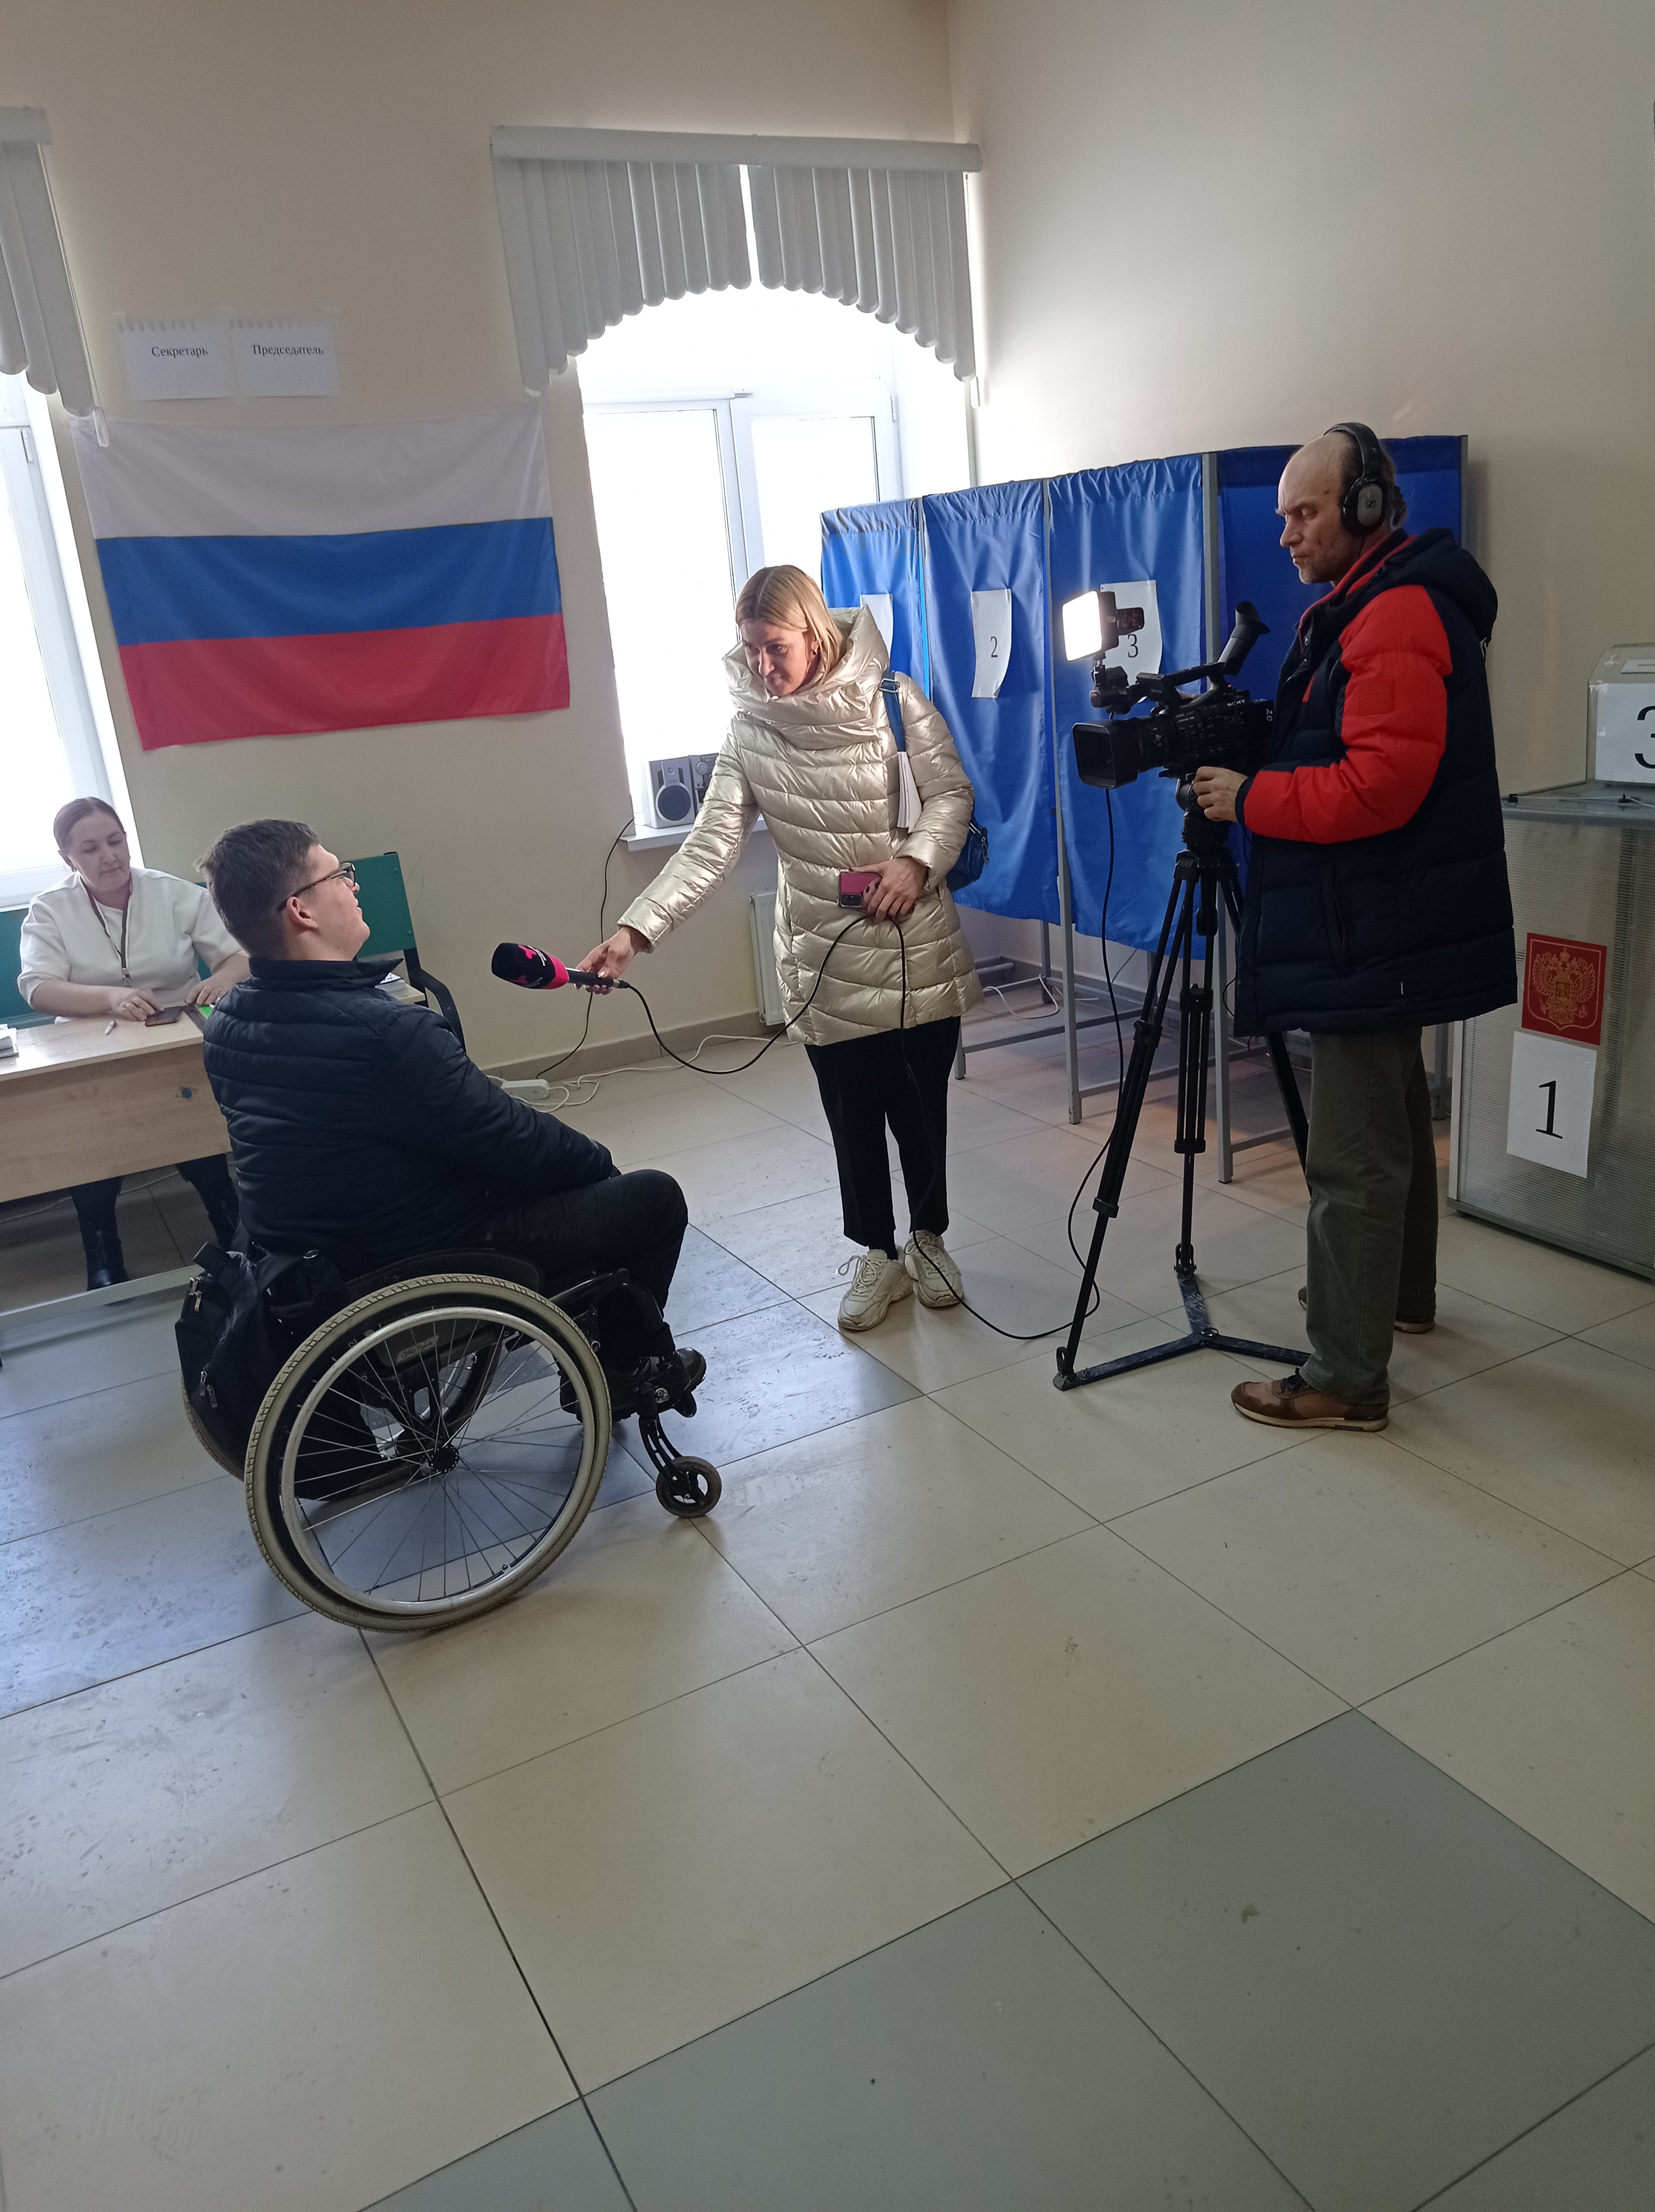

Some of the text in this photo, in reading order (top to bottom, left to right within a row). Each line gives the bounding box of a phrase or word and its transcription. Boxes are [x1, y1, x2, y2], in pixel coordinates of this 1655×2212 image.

[152, 346, 208, 358] Секретарь
[253, 344, 324, 357] Председатель
[990, 636, 998, 658] 2
[1127, 634, 1138, 658] 3
[1536, 1080, 1563, 1139] 1
